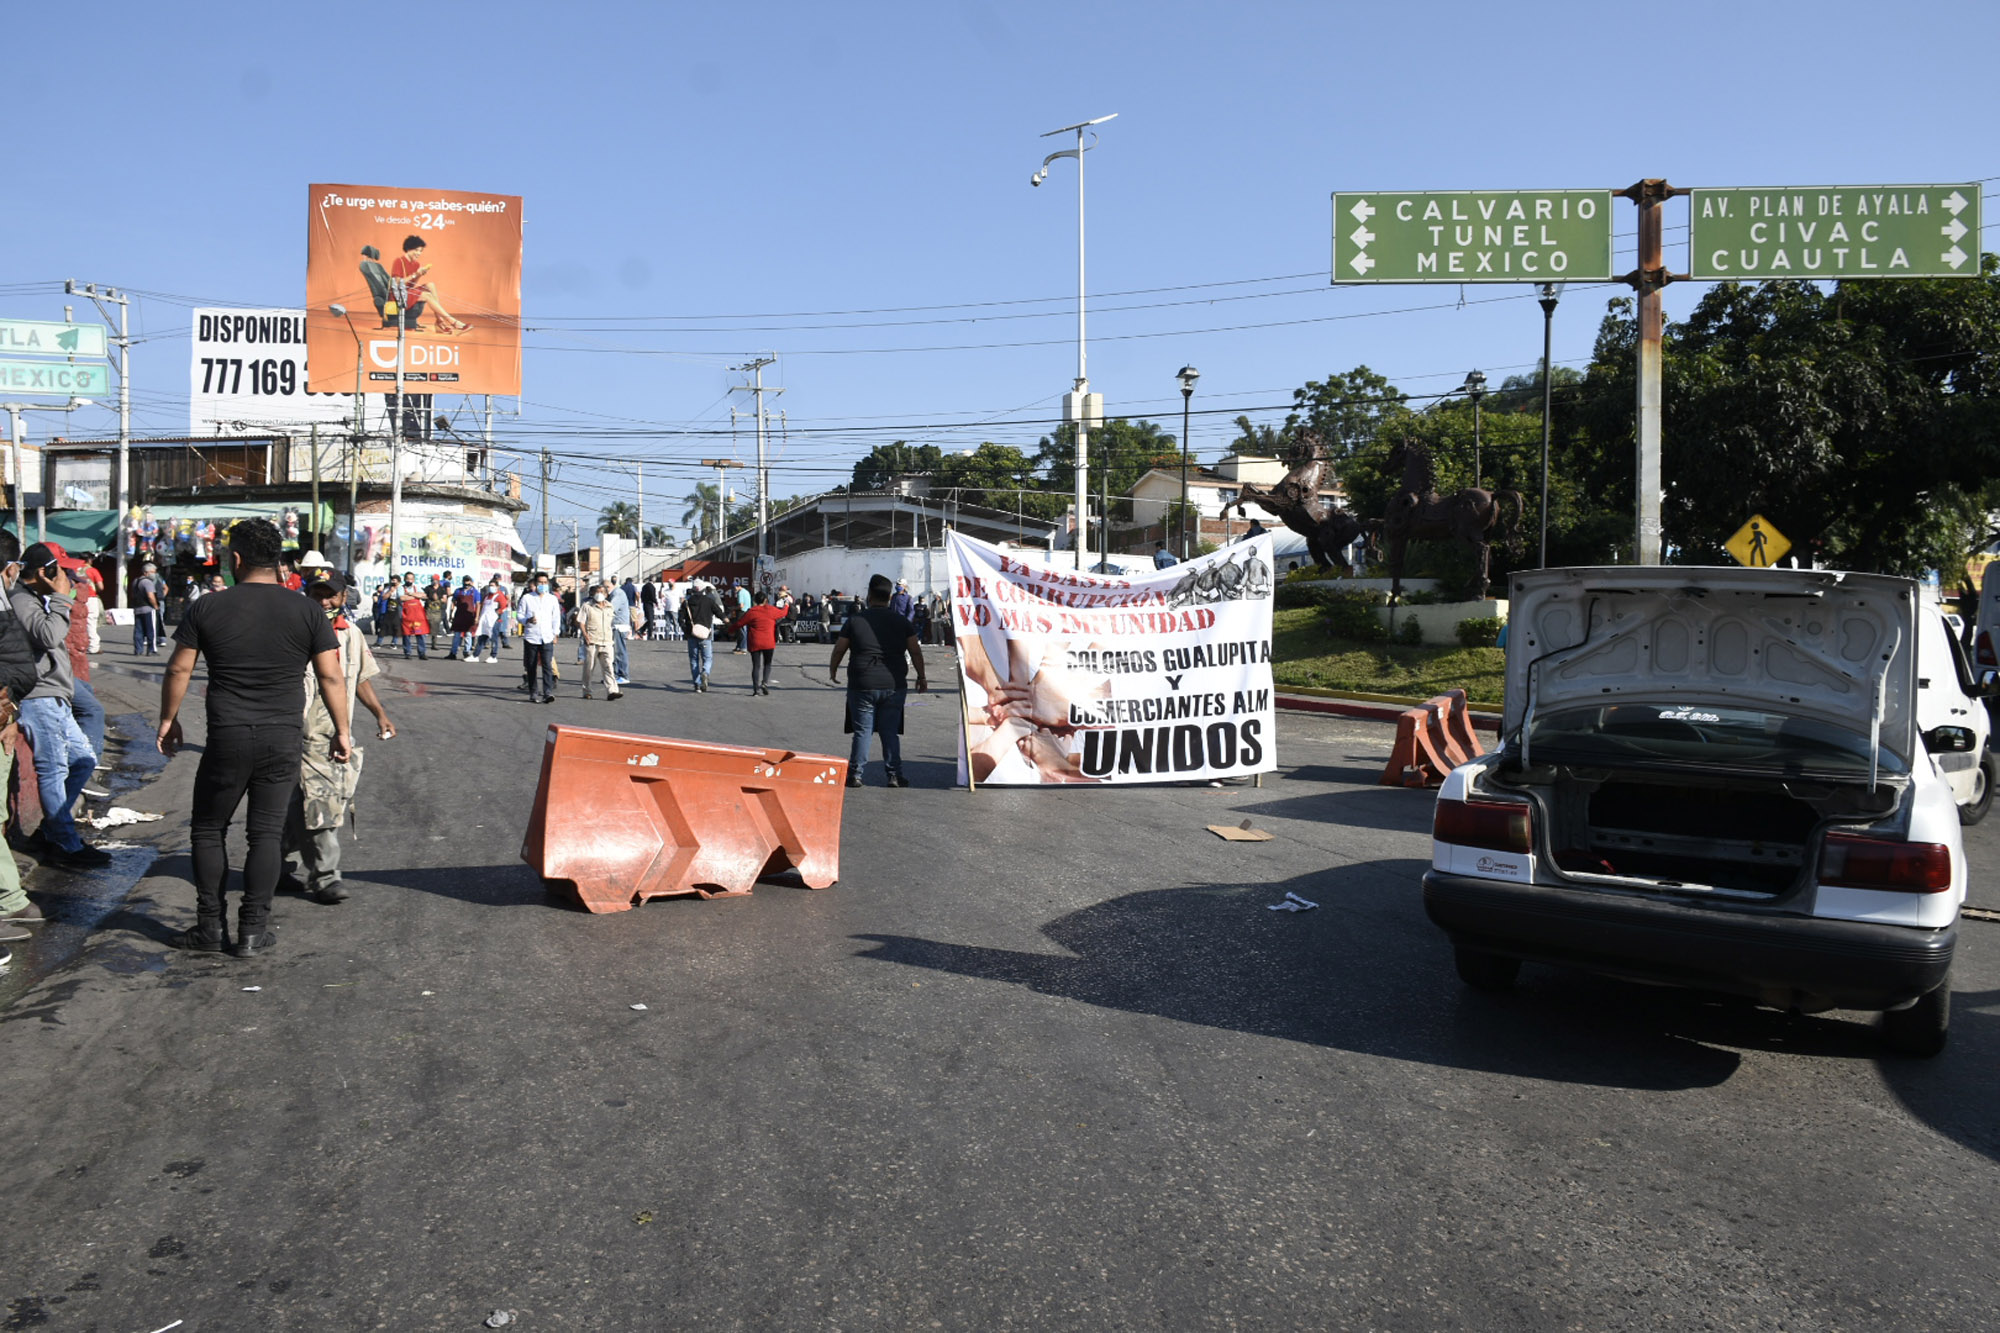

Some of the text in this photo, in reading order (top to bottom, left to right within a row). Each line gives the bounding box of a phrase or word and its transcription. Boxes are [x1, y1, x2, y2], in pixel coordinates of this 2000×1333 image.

[322, 193, 506, 214] ¿Te urge ver a ya-sabes-quién?
[1396, 198, 1595, 221] CALVARIO
[1702, 194, 1928, 218] AV. PLAN DE AYALA
[374, 215, 384, 223] Ve
[386, 215, 411, 224] desde
[1428, 225, 1557, 247] TUNEL
[1750, 221, 1879, 244] CIVAC
[1417, 251, 1568, 273] MEXICO
[1711, 247, 1910, 271] CUAUTLA
[410, 345, 460, 366] DiDi
[201, 358, 243, 394] 777
[248, 358, 296, 396] 169
[401, 555, 465, 569] DESECHABLES
[999, 555, 1031, 577] YA
[1039, 568, 1131, 589] BASTA
[956, 575, 1170, 609] DE CORRUPCIÓN
[998, 607, 1053, 634] MAS
[1066, 639, 1272, 674] COLONOS GUALUPITA
[1165, 674, 1183, 691] Y
[1069, 688, 1269, 725] COMERCIANTES ALM
[1082, 719, 1263, 777] UNIDOS
